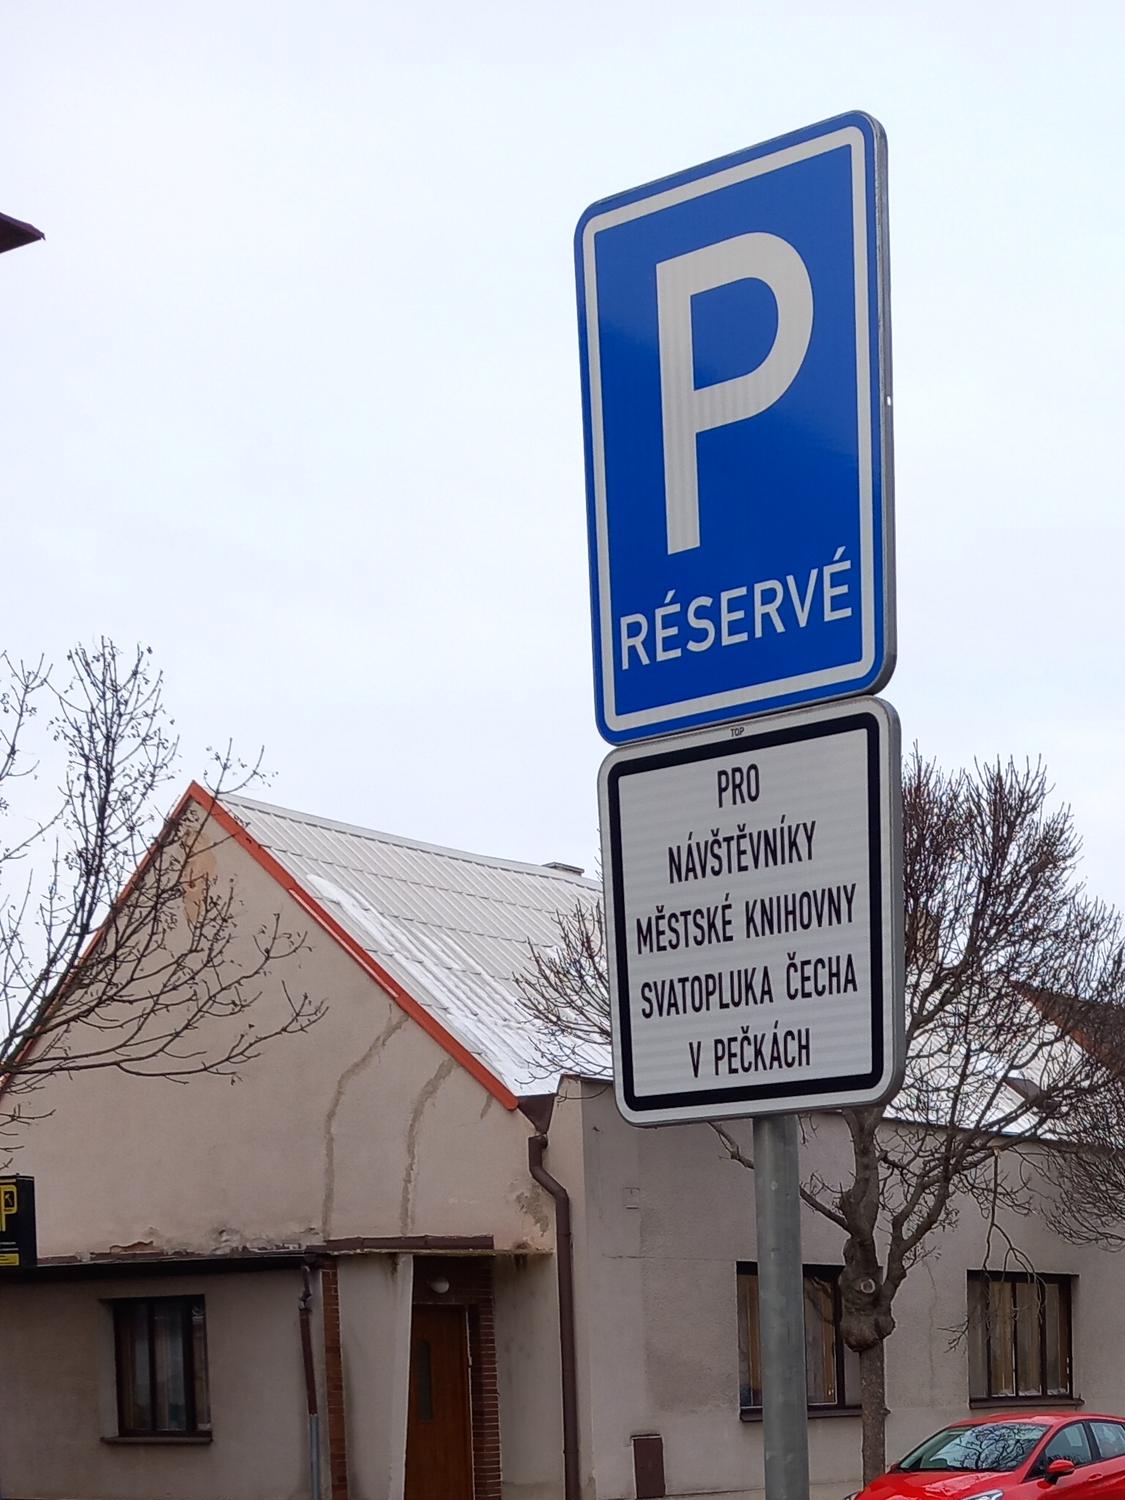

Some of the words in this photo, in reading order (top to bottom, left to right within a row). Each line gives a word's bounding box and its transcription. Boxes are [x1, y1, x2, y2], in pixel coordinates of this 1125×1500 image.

[655, 230, 815, 556] P
[618, 546, 854, 671] RÉSERVÉ
[716, 762, 761, 809] PRO
[668, 814, 817, 885] NÁVŠTĚVNÍKY
[636, 892, 735, 956] MĚSTSKÉ
[745, 882, 858, 940] KNIHOVNY
[640, 964, 775, 1020] SVATOPLUKA
[785, 951, 859, 1003] ČECHA
[688, 1040, 702, 1079] V
[714, 1019, 812, 1077] PEČKÁCH
